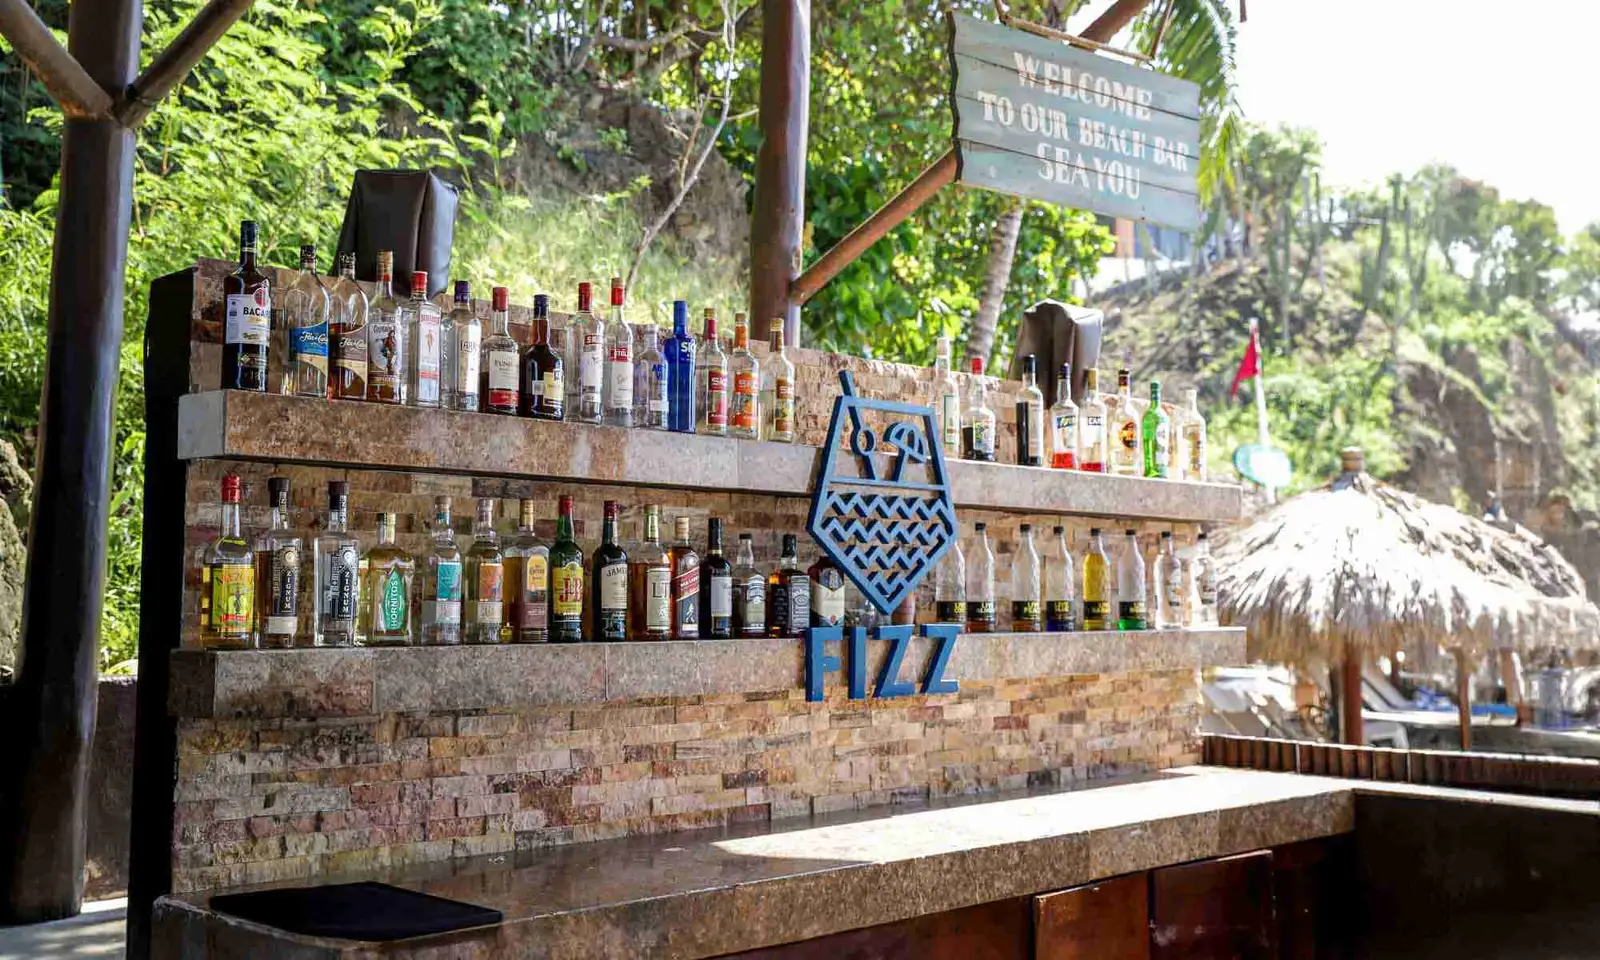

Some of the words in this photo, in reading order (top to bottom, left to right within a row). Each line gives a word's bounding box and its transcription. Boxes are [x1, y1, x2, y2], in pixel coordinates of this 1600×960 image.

[1013, 51, 1153, 122] WELCOME
[977, 89, 1014, 127] TO
[1020, 101, 1069, 142] OUR
[1079, 116, 1146, 161] BEACH
[1152, 135, 1189, 172] BAR
[1036, 141, 1090, 189] SEA
[1092, 155, 1140, 199] YOU
[342, 571, 350, 613] ZIGNUM
[391, 580, 399, 628] HORNITOS
[805, 623, 963, 702] FIZZ
